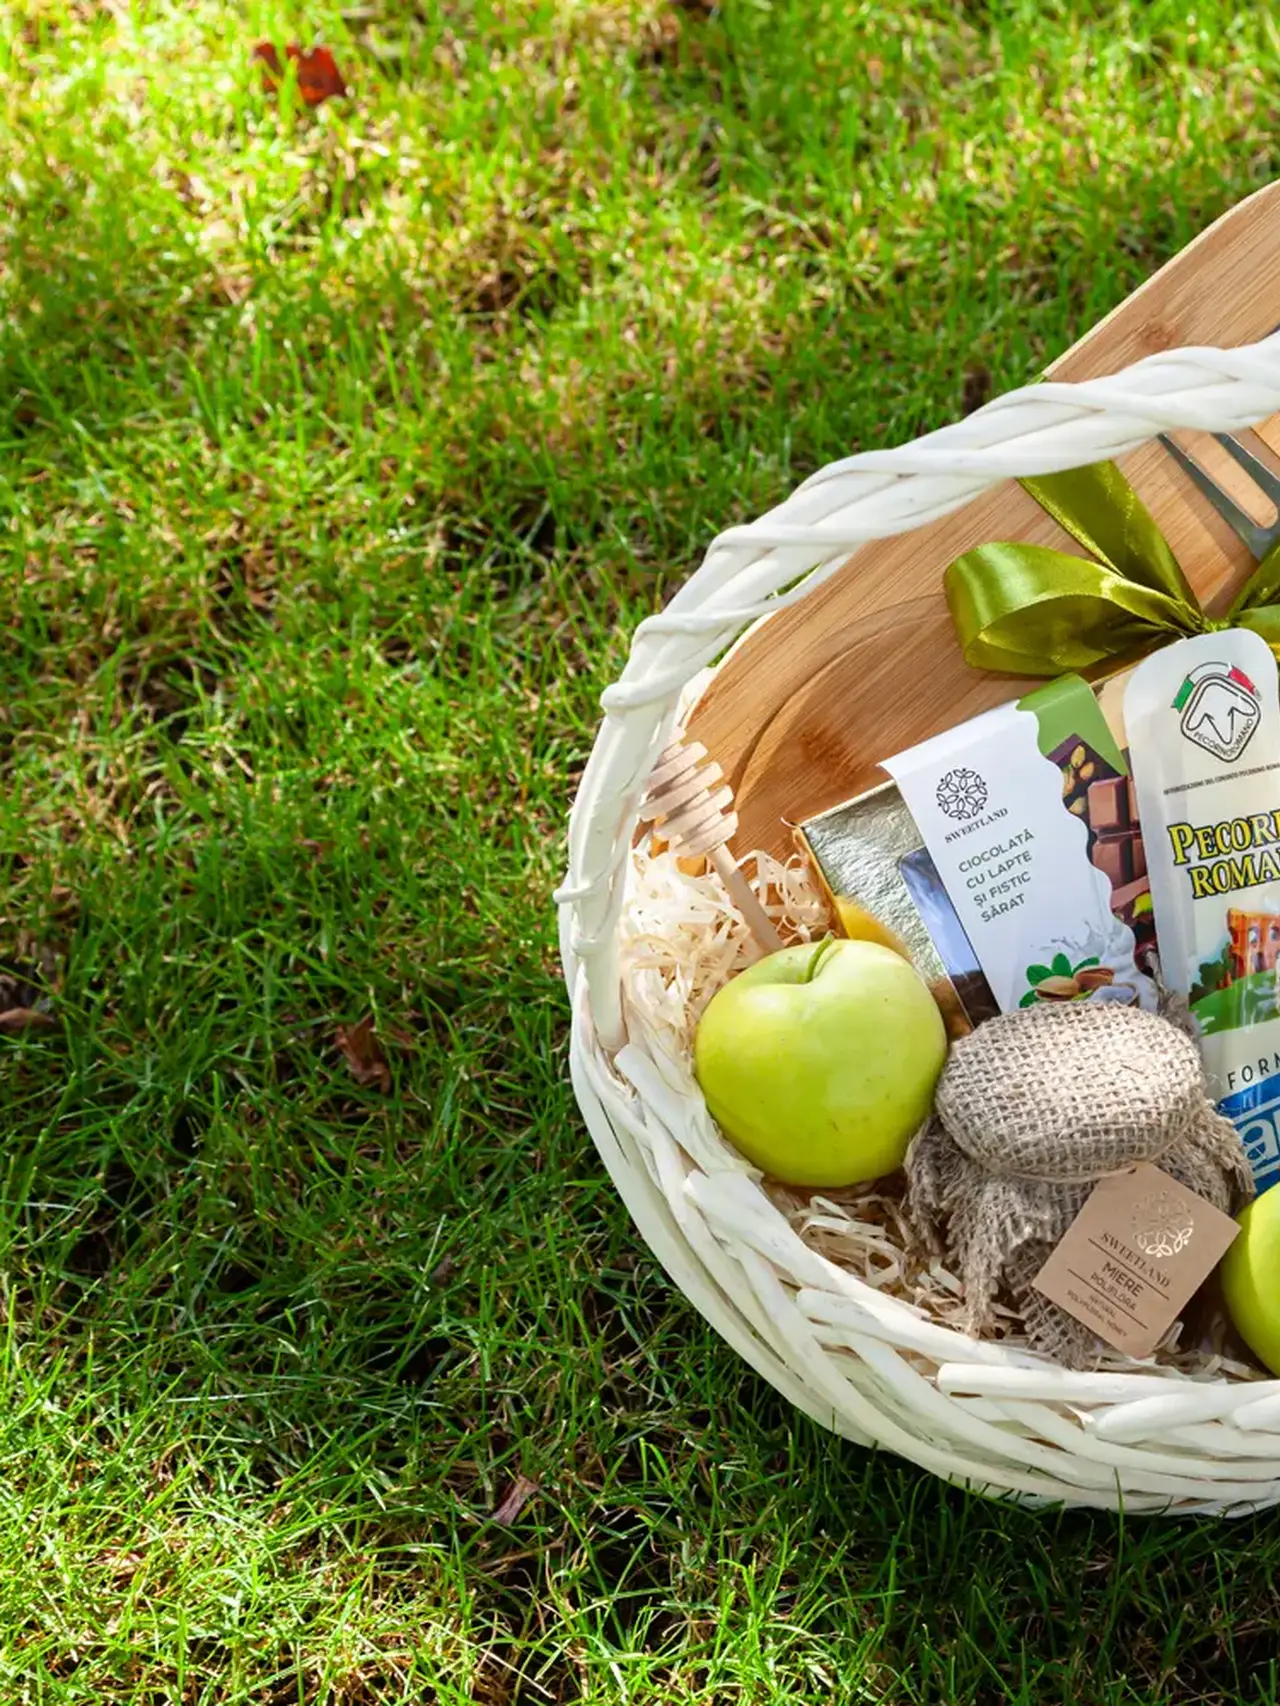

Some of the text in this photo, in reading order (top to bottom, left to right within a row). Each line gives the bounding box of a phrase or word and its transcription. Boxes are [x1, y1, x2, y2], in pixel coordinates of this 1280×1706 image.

[945, 808, 1008, 843] SWEETLAND
[958, 828, 1034, 873] CIOCOLATĂ
[966, 851, 1032, 890] CU LAPTE
[990, 871, 1031, 898] FISTIC
[981, 893, 1026, 923] SĂRAT
[1101, 1233, 1170, 1288] SWEETLAND
[1091, 1272, 1136, 1311] POLIFLORA
[1102, 1262, 1144, 1297] MIERE
